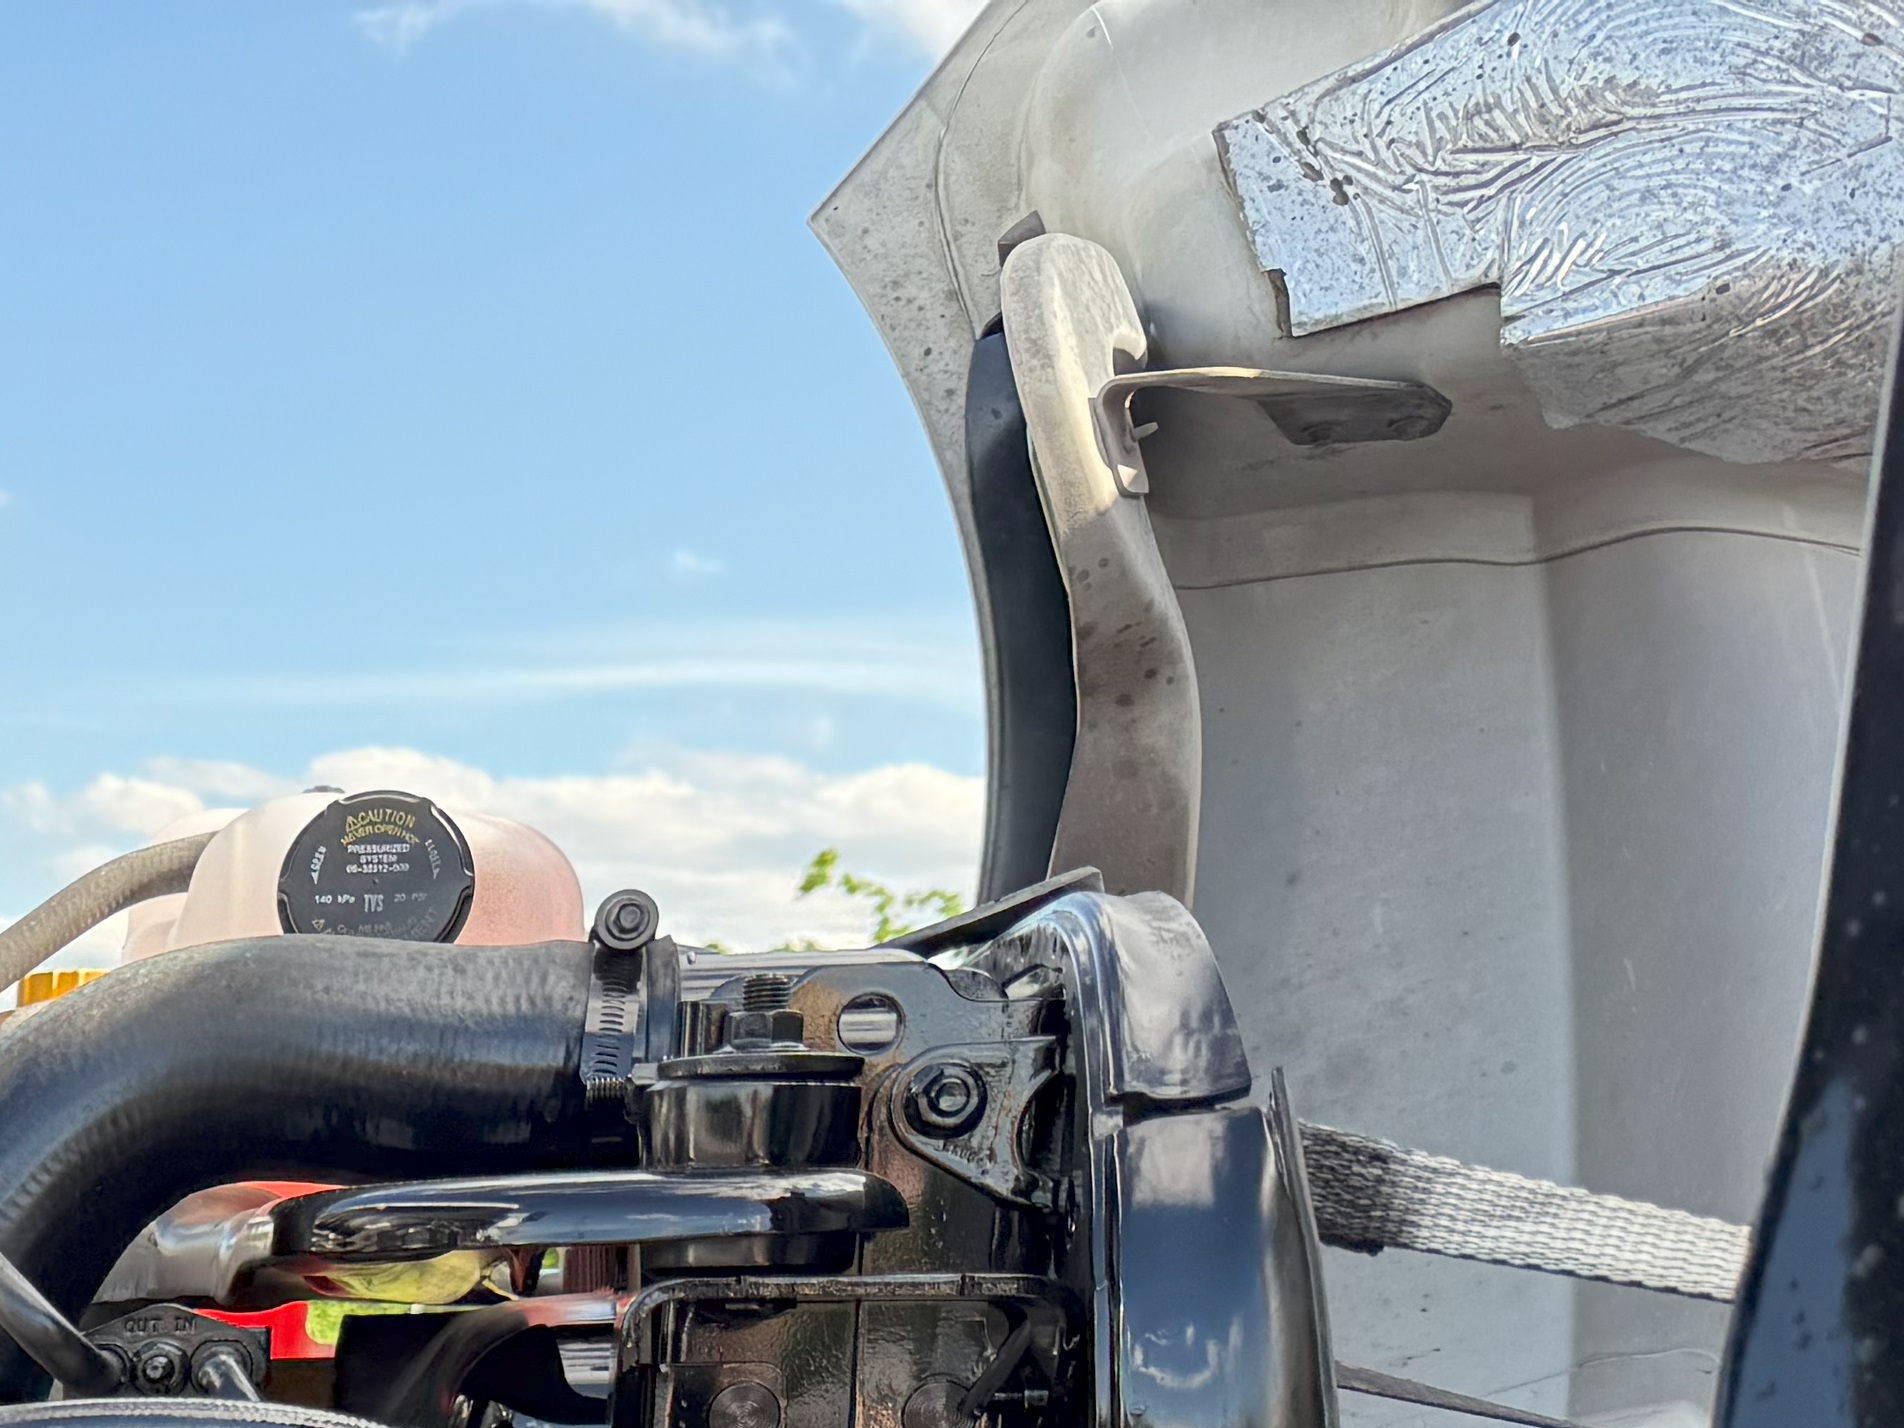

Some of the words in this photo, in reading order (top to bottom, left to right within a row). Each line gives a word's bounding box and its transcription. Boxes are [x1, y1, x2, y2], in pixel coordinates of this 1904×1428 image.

[358, 808, 416, 829] CAUTION
[347, 843, 411, 854] PRESSURIZED
[359, 855, 397, 864] SYSTEM
[315, 895, 333, 904] 140
[364, 894, 384, 912] TVS
[125, 1317, 162, 1333] OUT
